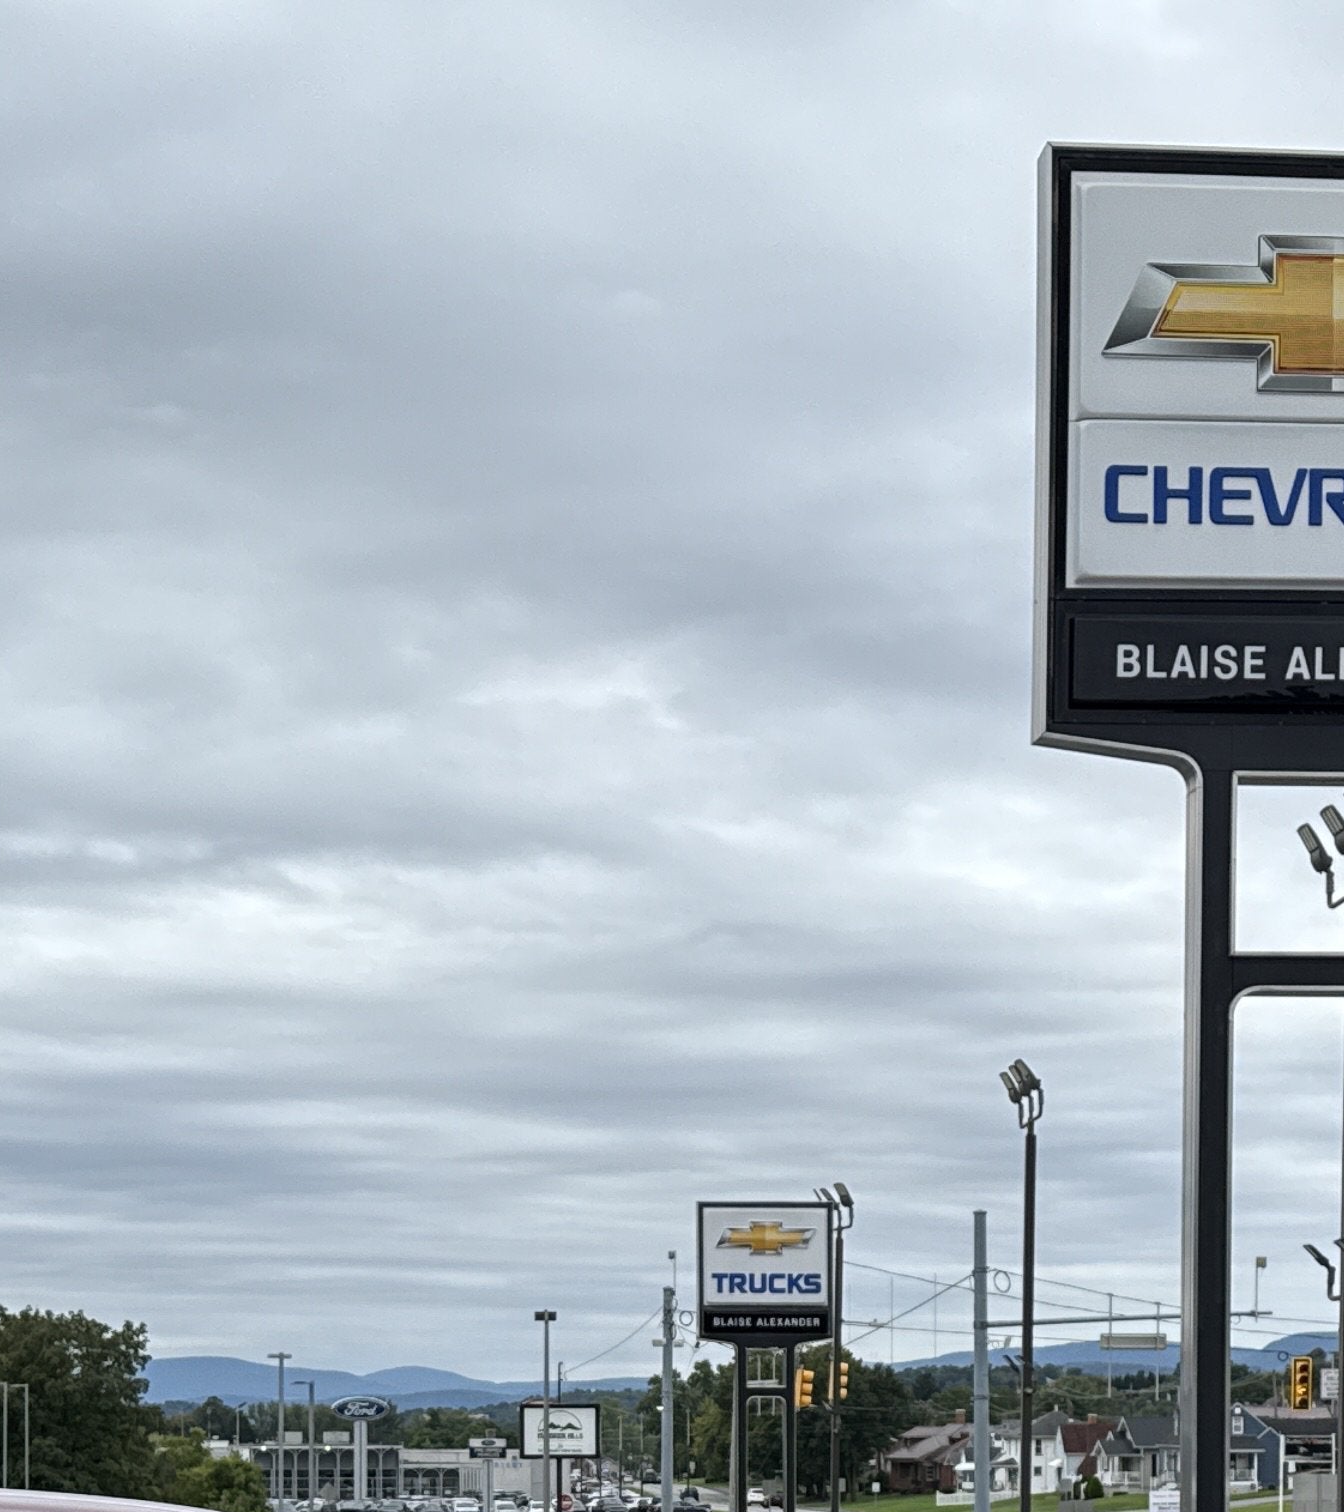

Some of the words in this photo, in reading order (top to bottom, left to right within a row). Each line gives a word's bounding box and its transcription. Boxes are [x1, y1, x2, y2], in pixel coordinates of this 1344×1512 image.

[1116, 643, 1266, 681] BLAISE
[711, 1272, 822, 1294] TRUCKS
[713, 1316, 753, 1327] BLAISE
[756, 1317, 821, 1327] ALEXANDER
[344, 1401, 378, 1416] Ford
